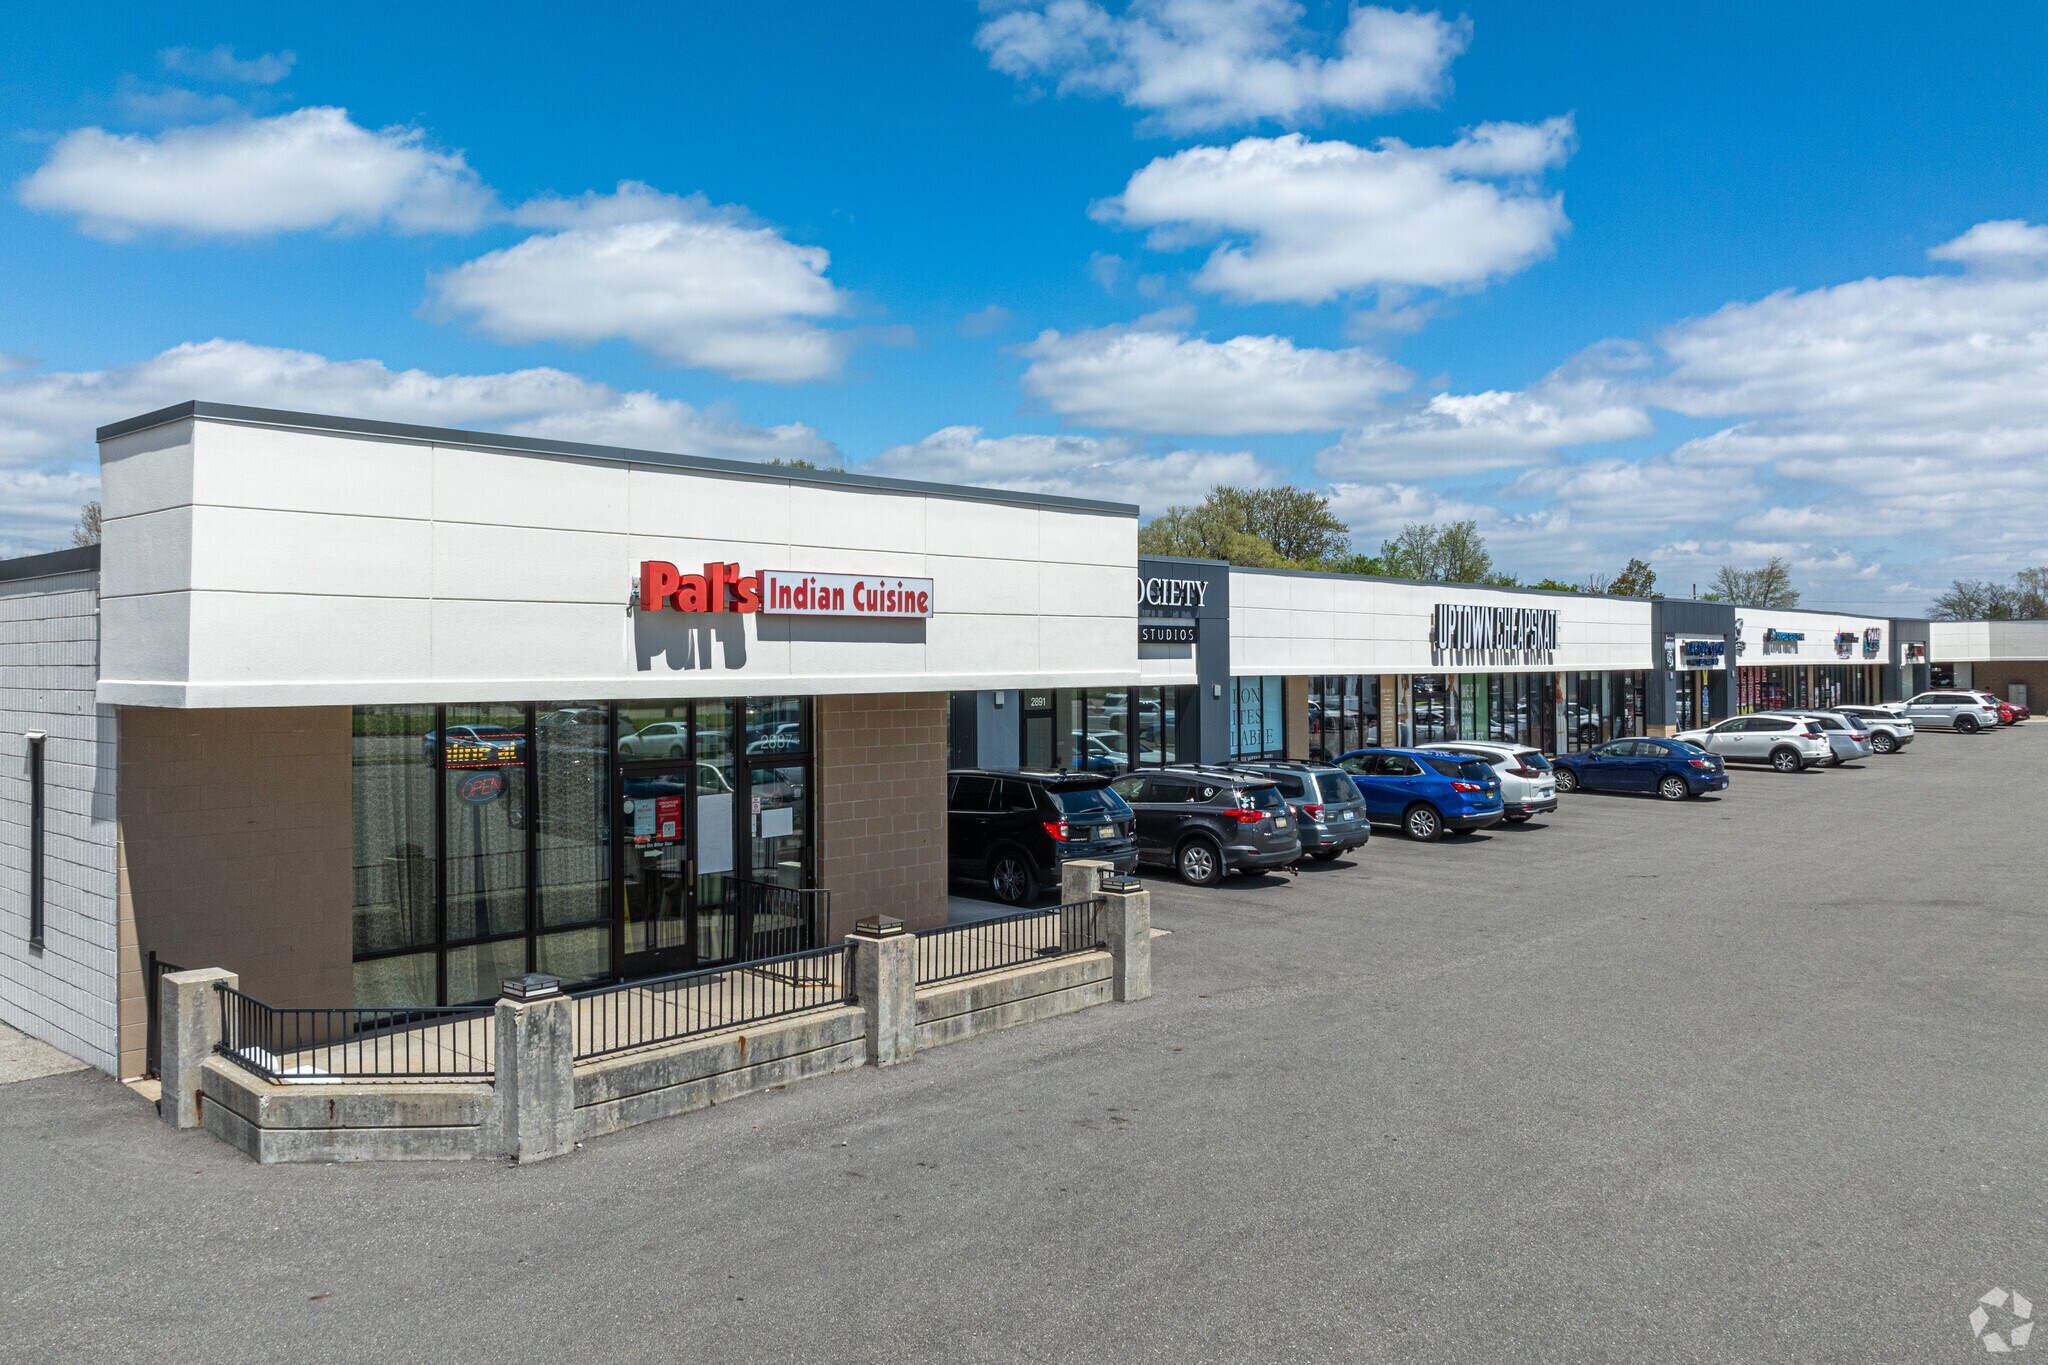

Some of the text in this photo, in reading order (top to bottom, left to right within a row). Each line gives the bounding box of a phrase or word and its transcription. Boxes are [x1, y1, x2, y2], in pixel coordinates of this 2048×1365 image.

[640, 560, 759, 614] Pal's
[769, 577, 930, 614] Indian Cuisine
[1142, 628, 1194, 641] STUDIOS
[1438, 604, 1561, 650] UPTOWN CHEAPSKATE
[1030, 697, 1046, 707] 2891
[760, 733, 793, 750] 2887
[461, 776, 503, 799] OPEN
